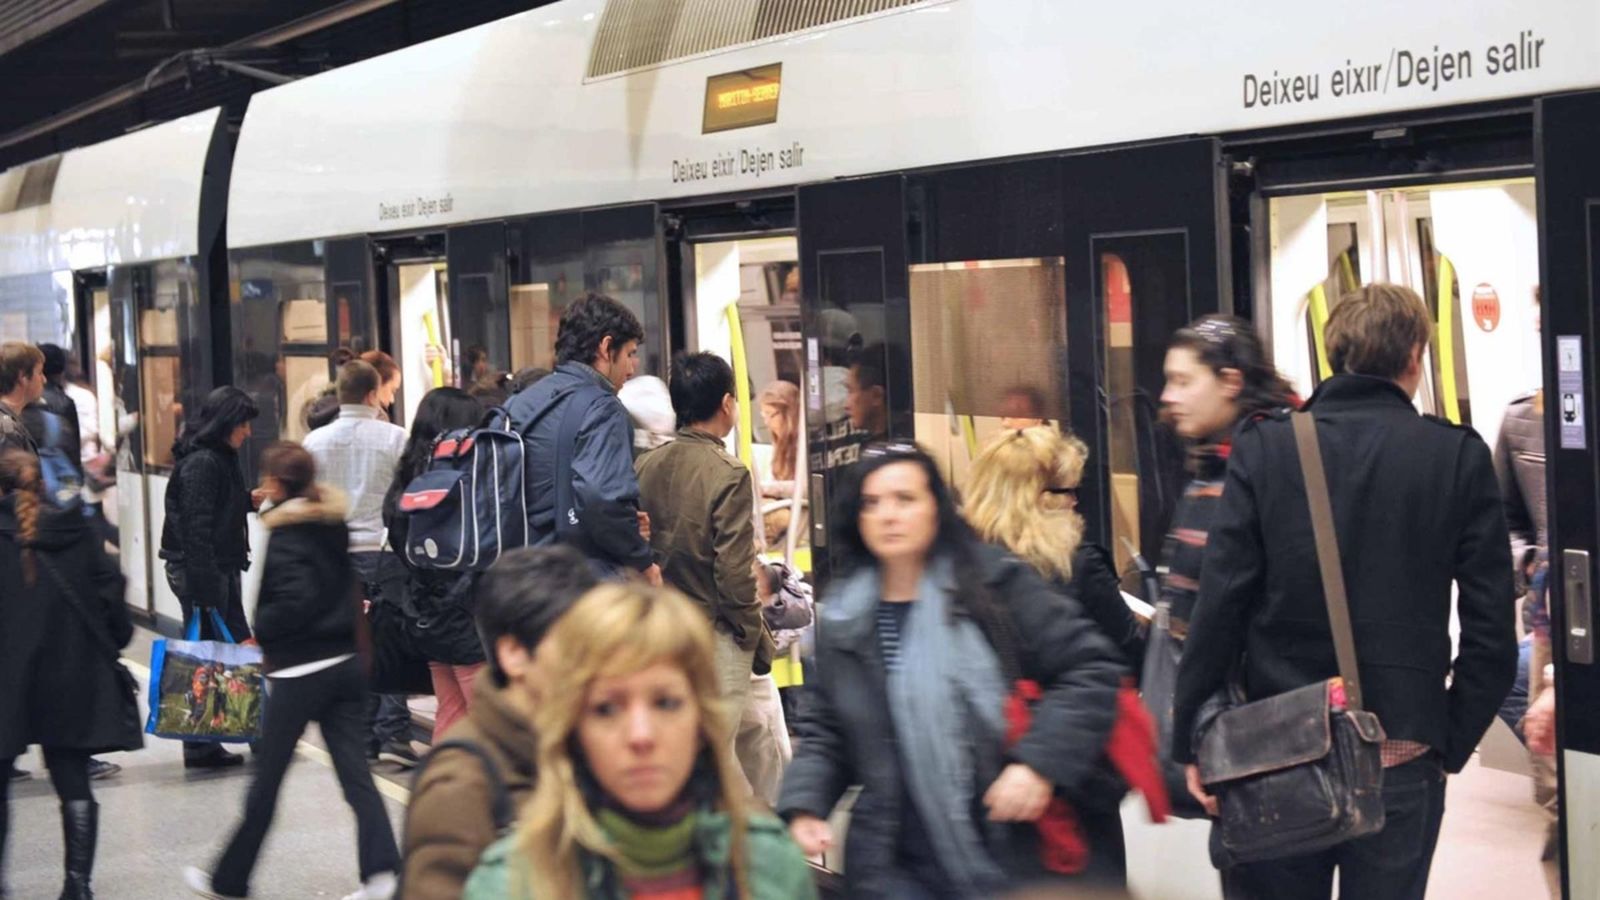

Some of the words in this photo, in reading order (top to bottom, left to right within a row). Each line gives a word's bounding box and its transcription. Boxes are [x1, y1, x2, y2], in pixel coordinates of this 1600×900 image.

[1242, 70, 1320, 109] Deixeu
[1485, 29, 1545, 76] salir
[672, 157, 708, 184] Deixeu
[779, 140, 804, 170] salir
